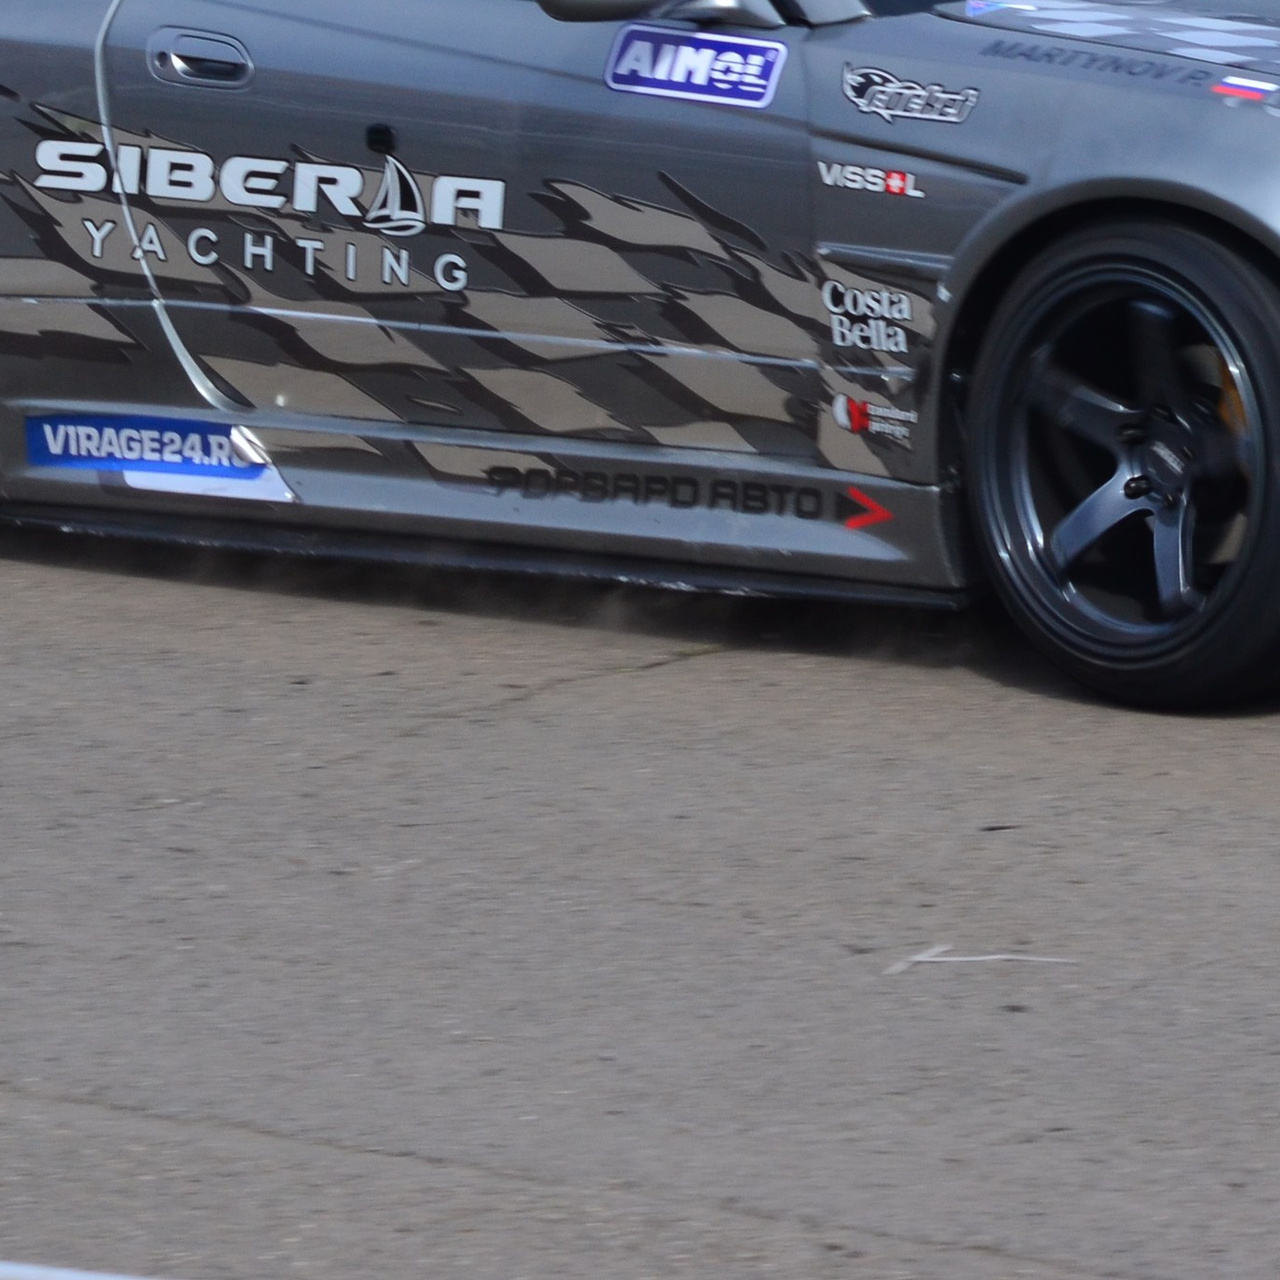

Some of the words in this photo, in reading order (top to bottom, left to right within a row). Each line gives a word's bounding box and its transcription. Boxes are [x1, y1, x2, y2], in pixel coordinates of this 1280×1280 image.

[614, 39, 769, 93] AIMOL
[82, 218, 470, 292] YACHTING
[821, 279, 914, 321] Costa
[829, 313, 910, 354] Bella
[708, 479, 823, 520] АВТО
